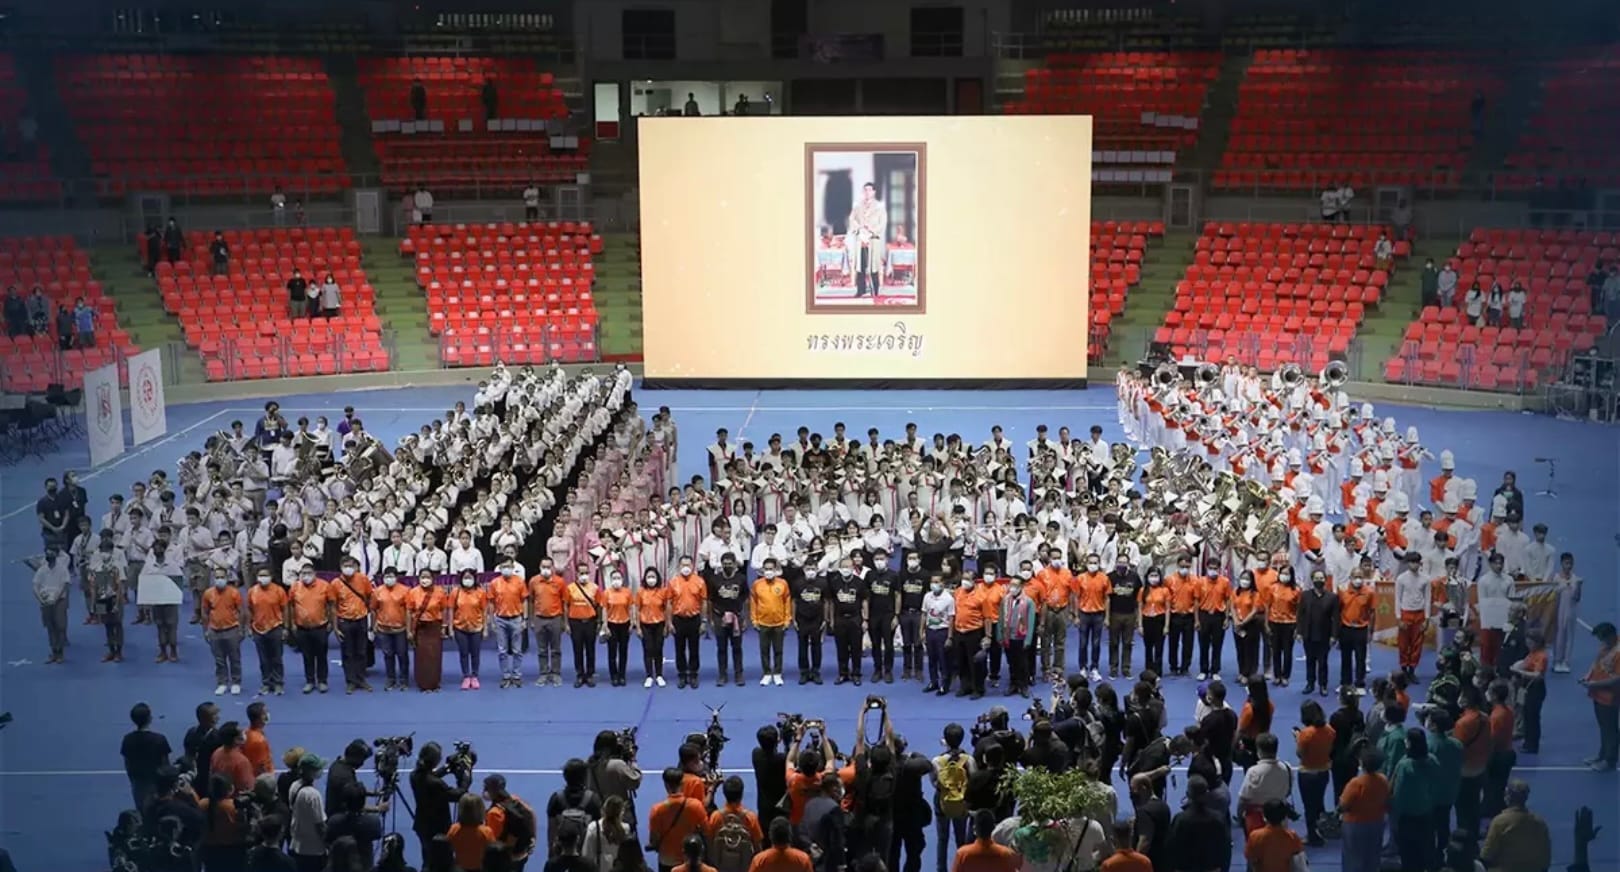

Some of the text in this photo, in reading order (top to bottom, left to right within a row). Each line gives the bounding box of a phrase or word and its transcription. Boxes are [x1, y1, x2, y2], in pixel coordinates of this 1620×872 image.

[807, 321, 922, 356] ทรงพระเจริญ
